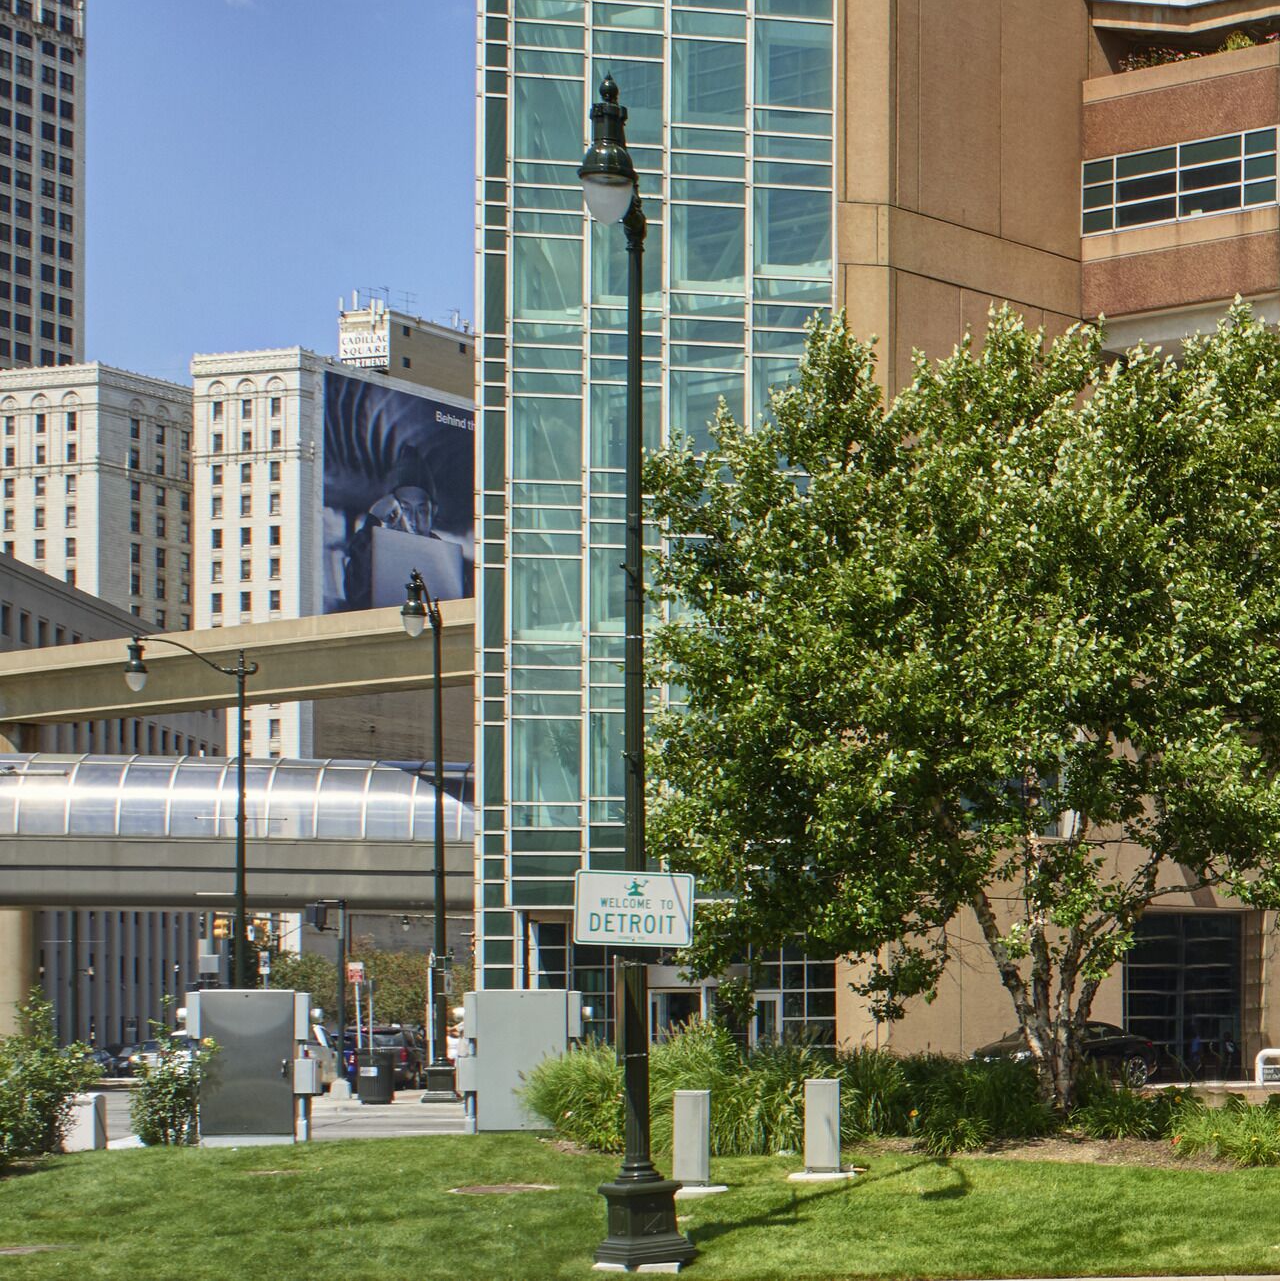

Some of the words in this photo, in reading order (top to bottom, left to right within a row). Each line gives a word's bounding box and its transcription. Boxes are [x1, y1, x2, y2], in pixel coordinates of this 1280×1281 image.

[342, 335, 388, 345] CADILLAC
[343, 345, 387, 356] SQUARE
[435, 411, 466, 429] Behind
[600, 898, 652, 910] WELCOME
[660, 899, 674, 910] TO
[590, 913, 676, 934] DETROIT
